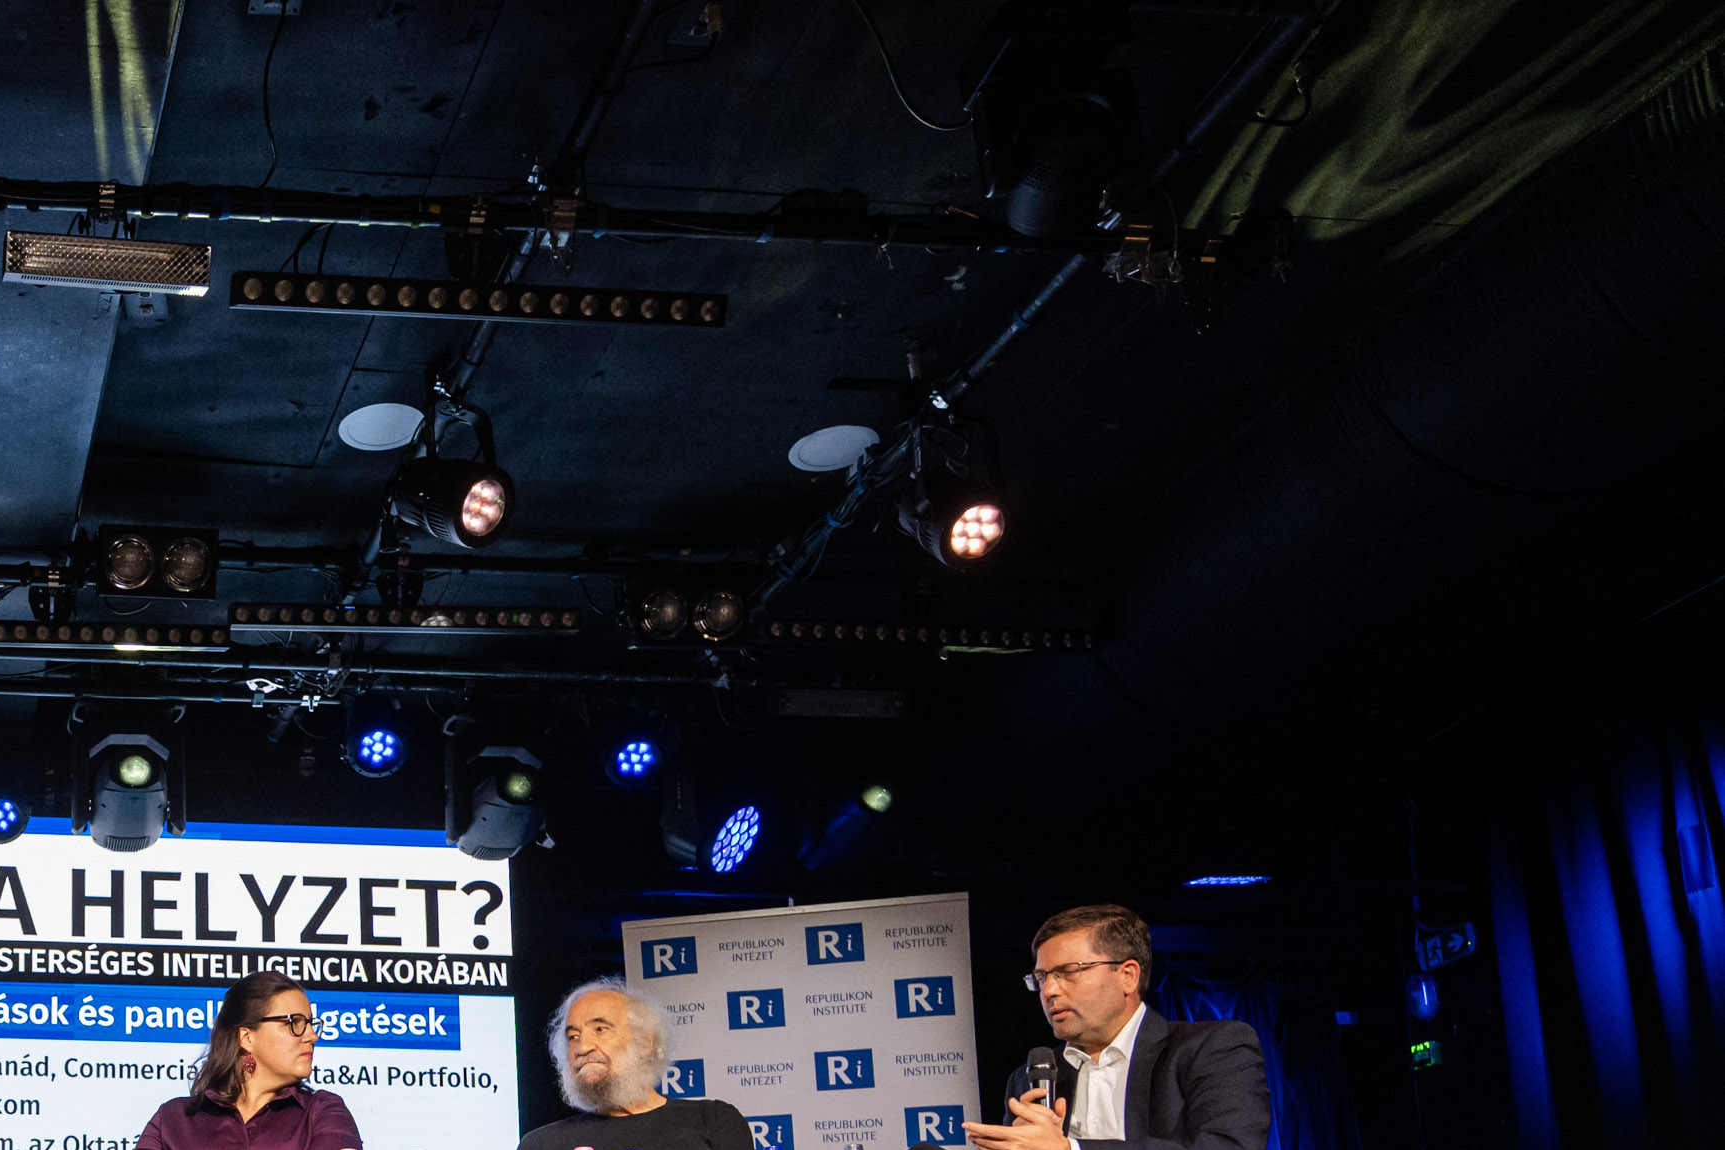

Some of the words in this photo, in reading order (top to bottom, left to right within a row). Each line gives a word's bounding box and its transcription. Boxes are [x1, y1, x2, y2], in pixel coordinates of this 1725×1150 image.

[71, 868, 504, 951] HELYZET?
[884, 923, 954, 939] REPUBLIKON
[718, 938, 785, 951] REPUBLIKON
[892, 936, 948, 950] INSTITUTE
[732, 949, 774, 962] INTÉZET
[163, 952, 368, 984] INTELLIGENCIA
[376, 954, 508, 987] KORÁBAN
[805, 990, 873, 1004] REPUBLIKON
[78, 994, 115, 1027] és
[666, 1002, 705, 1014] BLIKON
[813, 1003, 866, 1016] INSTITUTE
[895, 1051, 964, 1065] REPUBLIKON
[64, 1057, 196, 1081] Commercia
[387, 1066, 498, 1094] Portfolio,
[727, 1062, 794, 1075] REPUBLIKON
[903, 1064, 959, 1077] INSTITUTE
[740, 1073, 783, 1087] INTÉZET
[815, 1118, 883, 1130] REPUBLIKON
[822, 1131, 877, 1143] INSTITUTE
